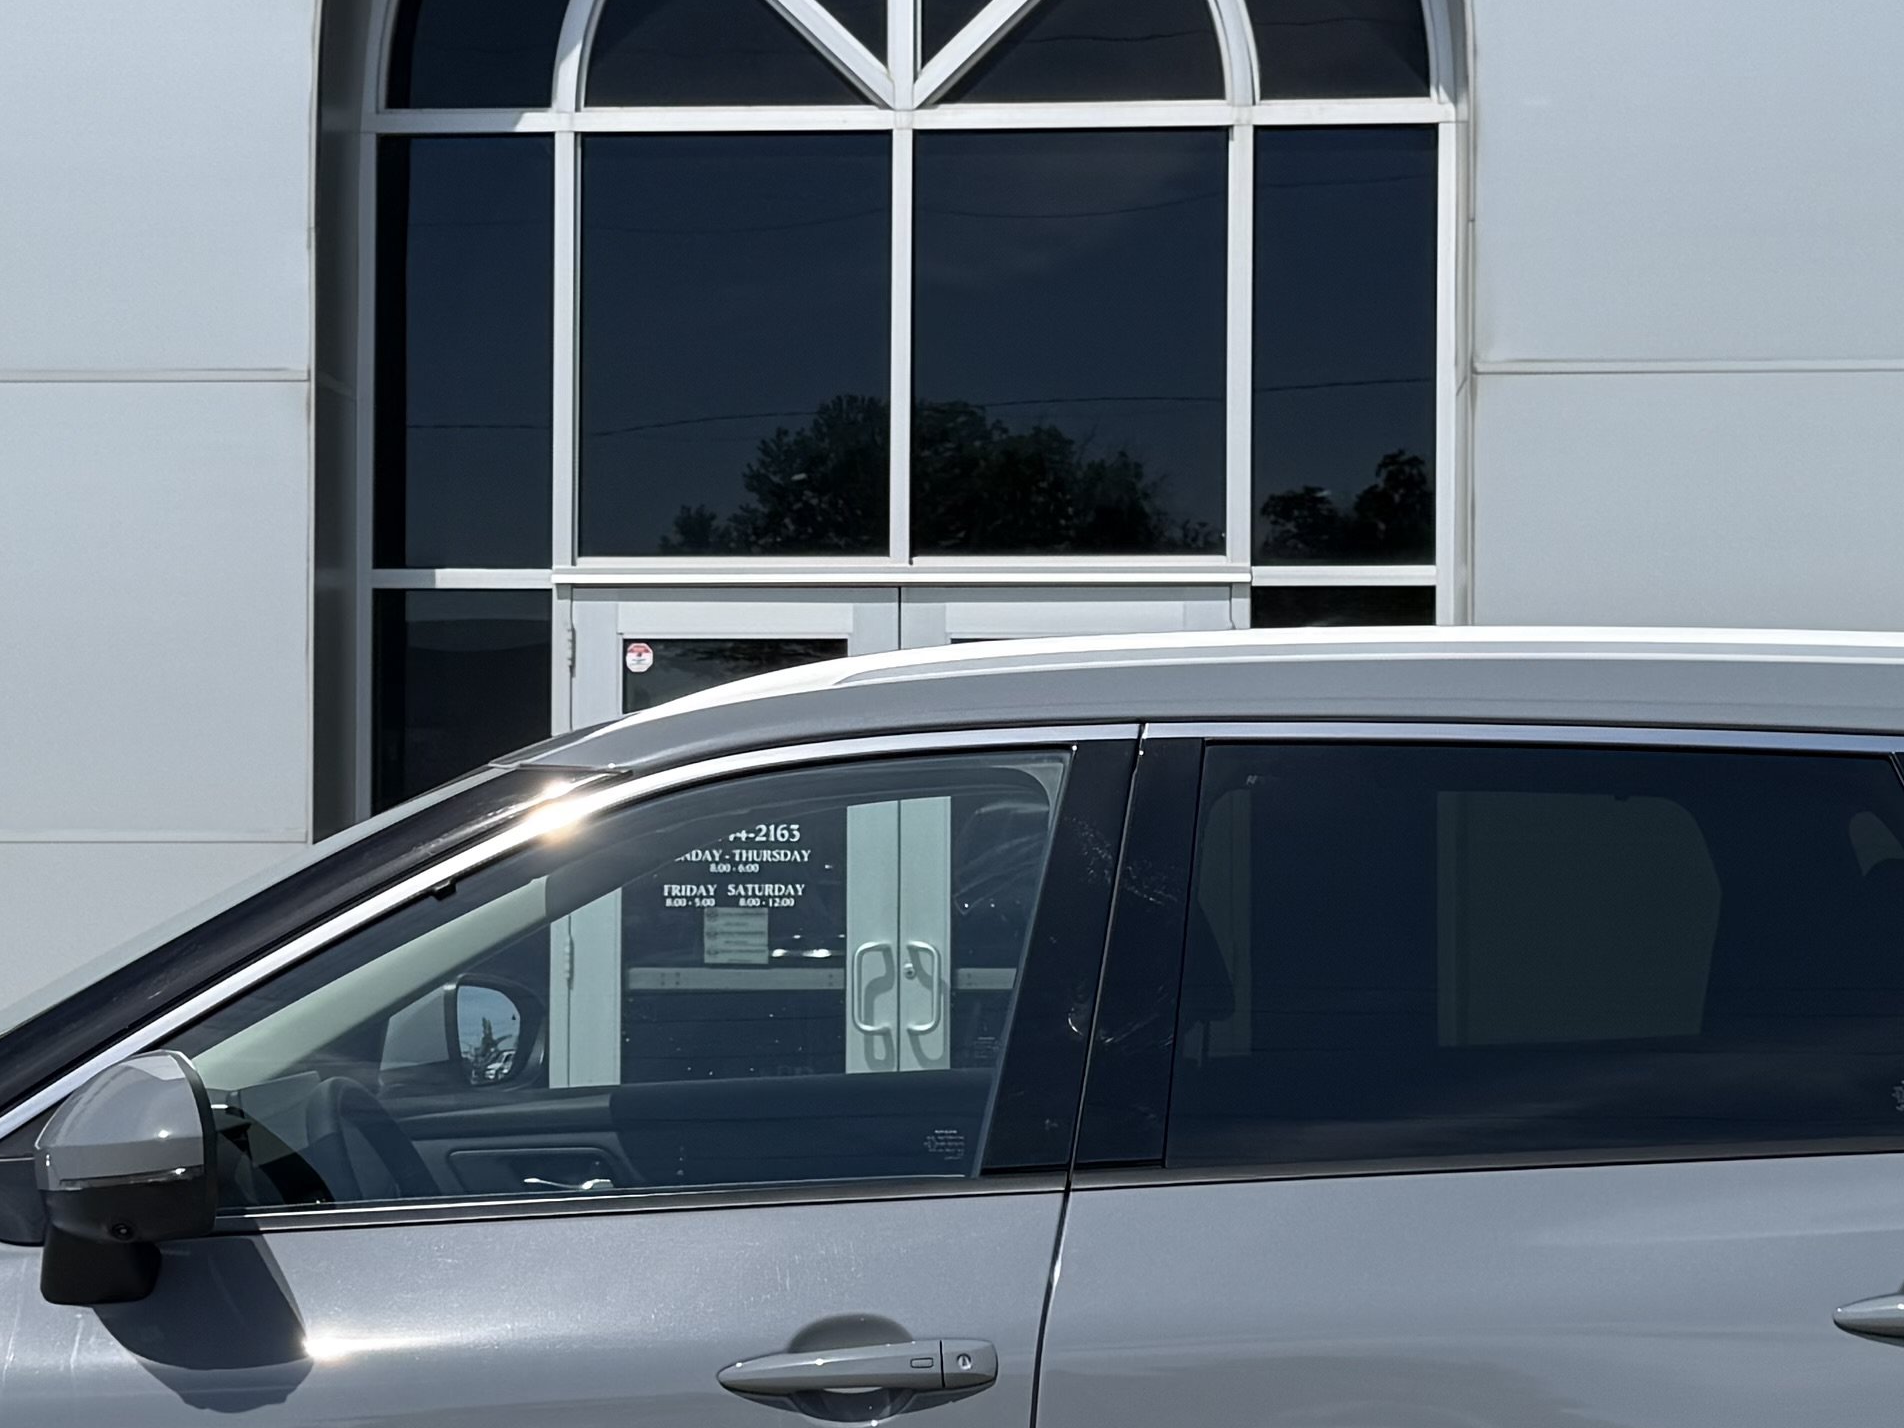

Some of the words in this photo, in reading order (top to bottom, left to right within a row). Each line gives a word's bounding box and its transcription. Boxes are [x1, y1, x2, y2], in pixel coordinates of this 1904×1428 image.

[732, 849, 811, 862] THURSDAY
[663, 883, 717, 897] FRIDAY
[727, 883, 805, 897] SATURDAY
